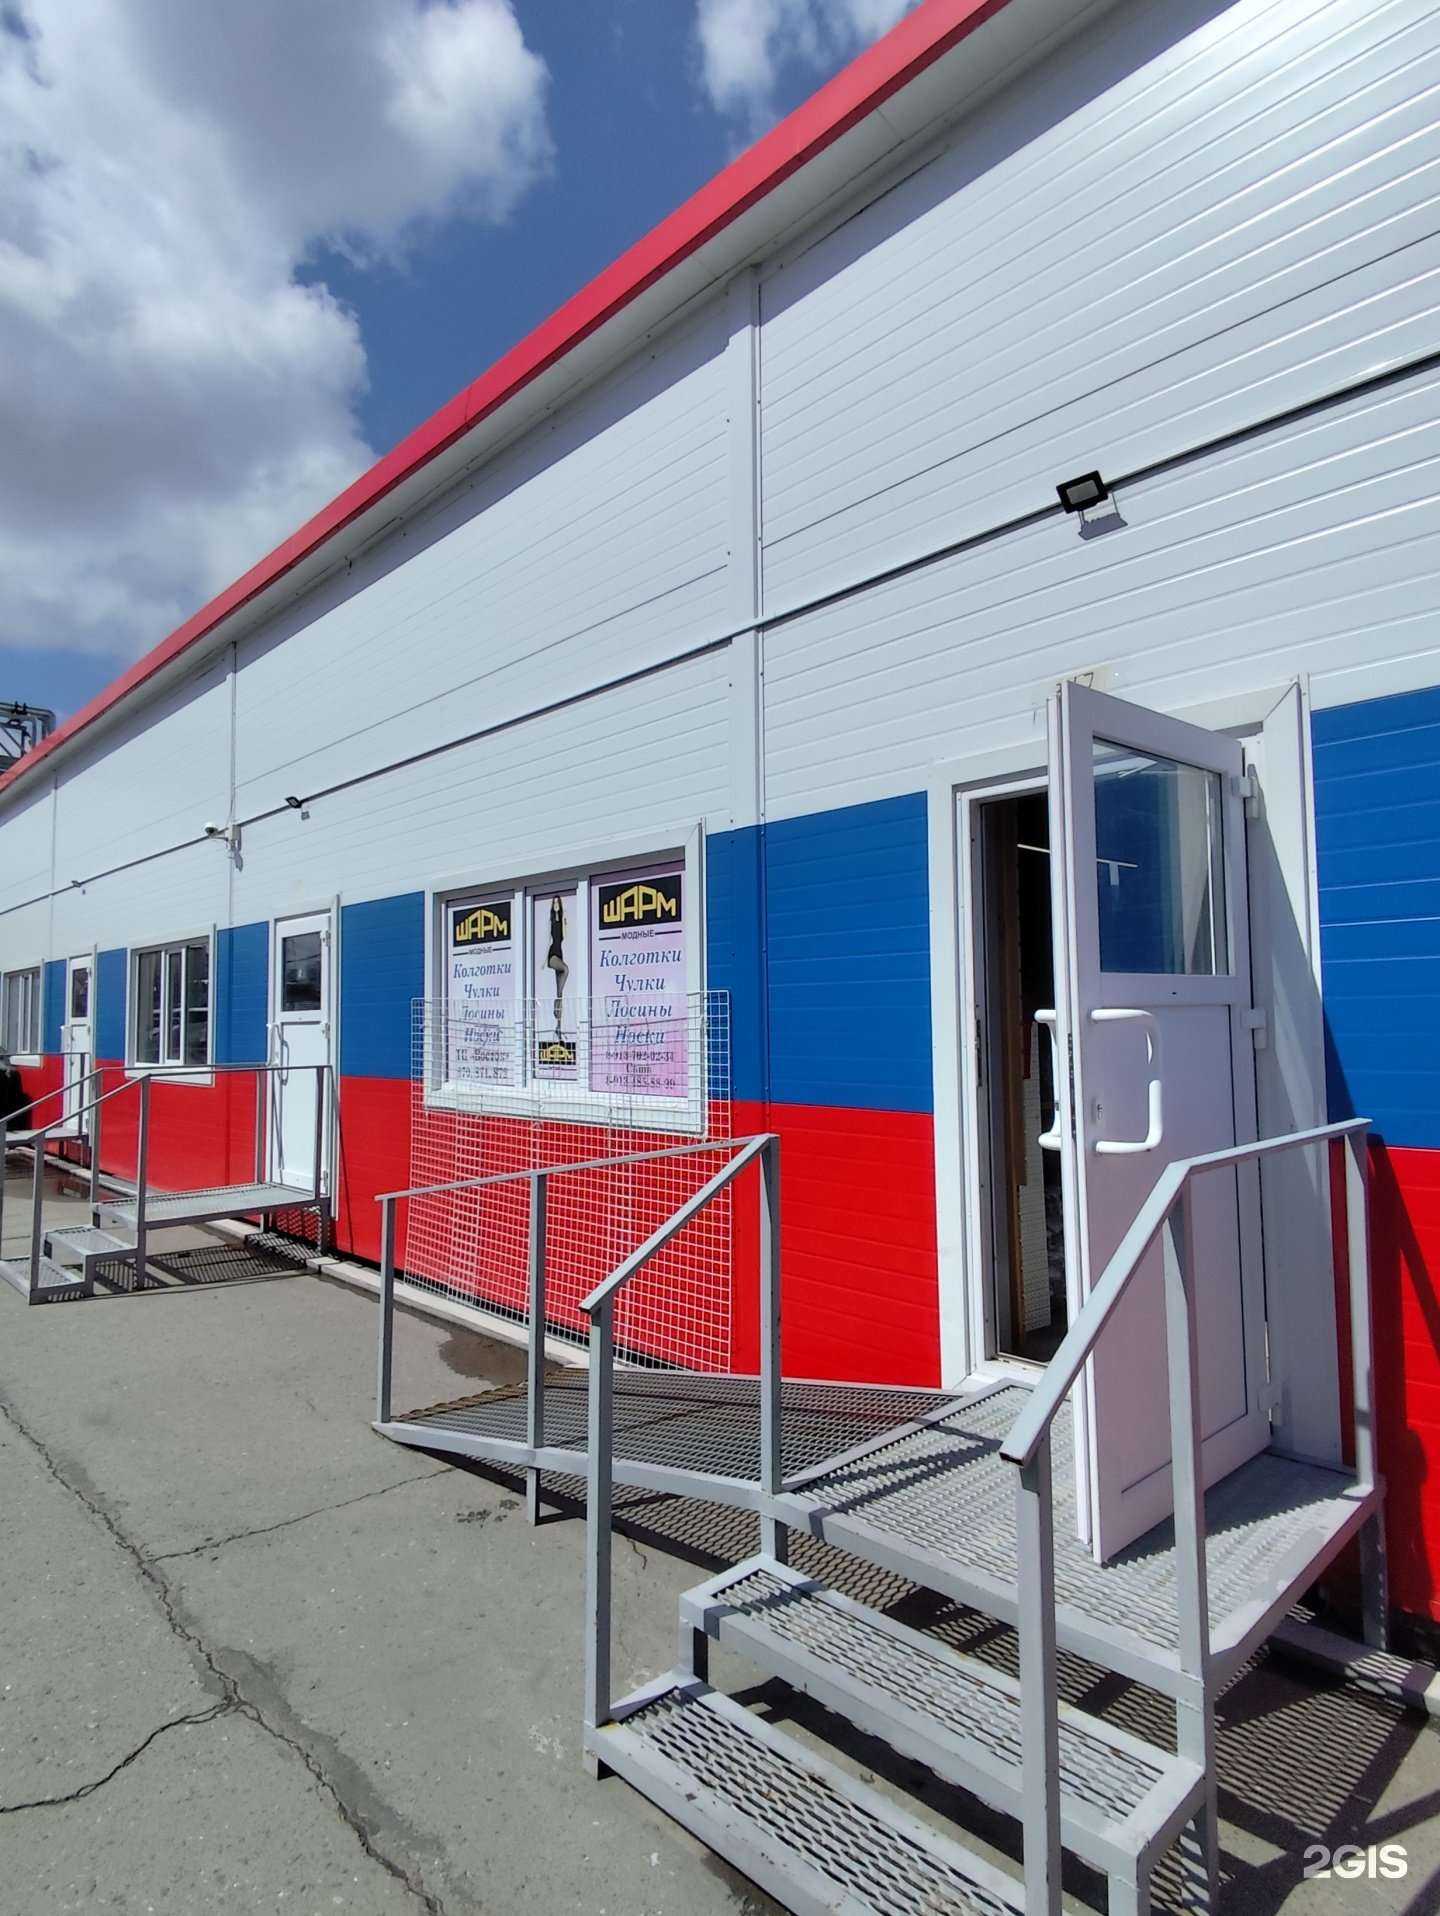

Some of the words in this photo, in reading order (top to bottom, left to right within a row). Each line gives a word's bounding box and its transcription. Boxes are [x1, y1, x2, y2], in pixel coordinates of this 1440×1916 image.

[604, 885, 677, 922] ШАРМ
[456, 908, 508, 941] ШАРМ
[621, 930, 655, 940] МОДНЫЕ
[600, 949, 682, 967] Колготки
[454, 963, 512, 979] Колготки
[464, 983, 500, 999] Чулки
[615, 974, 665, 991] Чулки
[607, 1000, 672, 1018] Лосины
[615, 1026, 665, 1044] Носки
